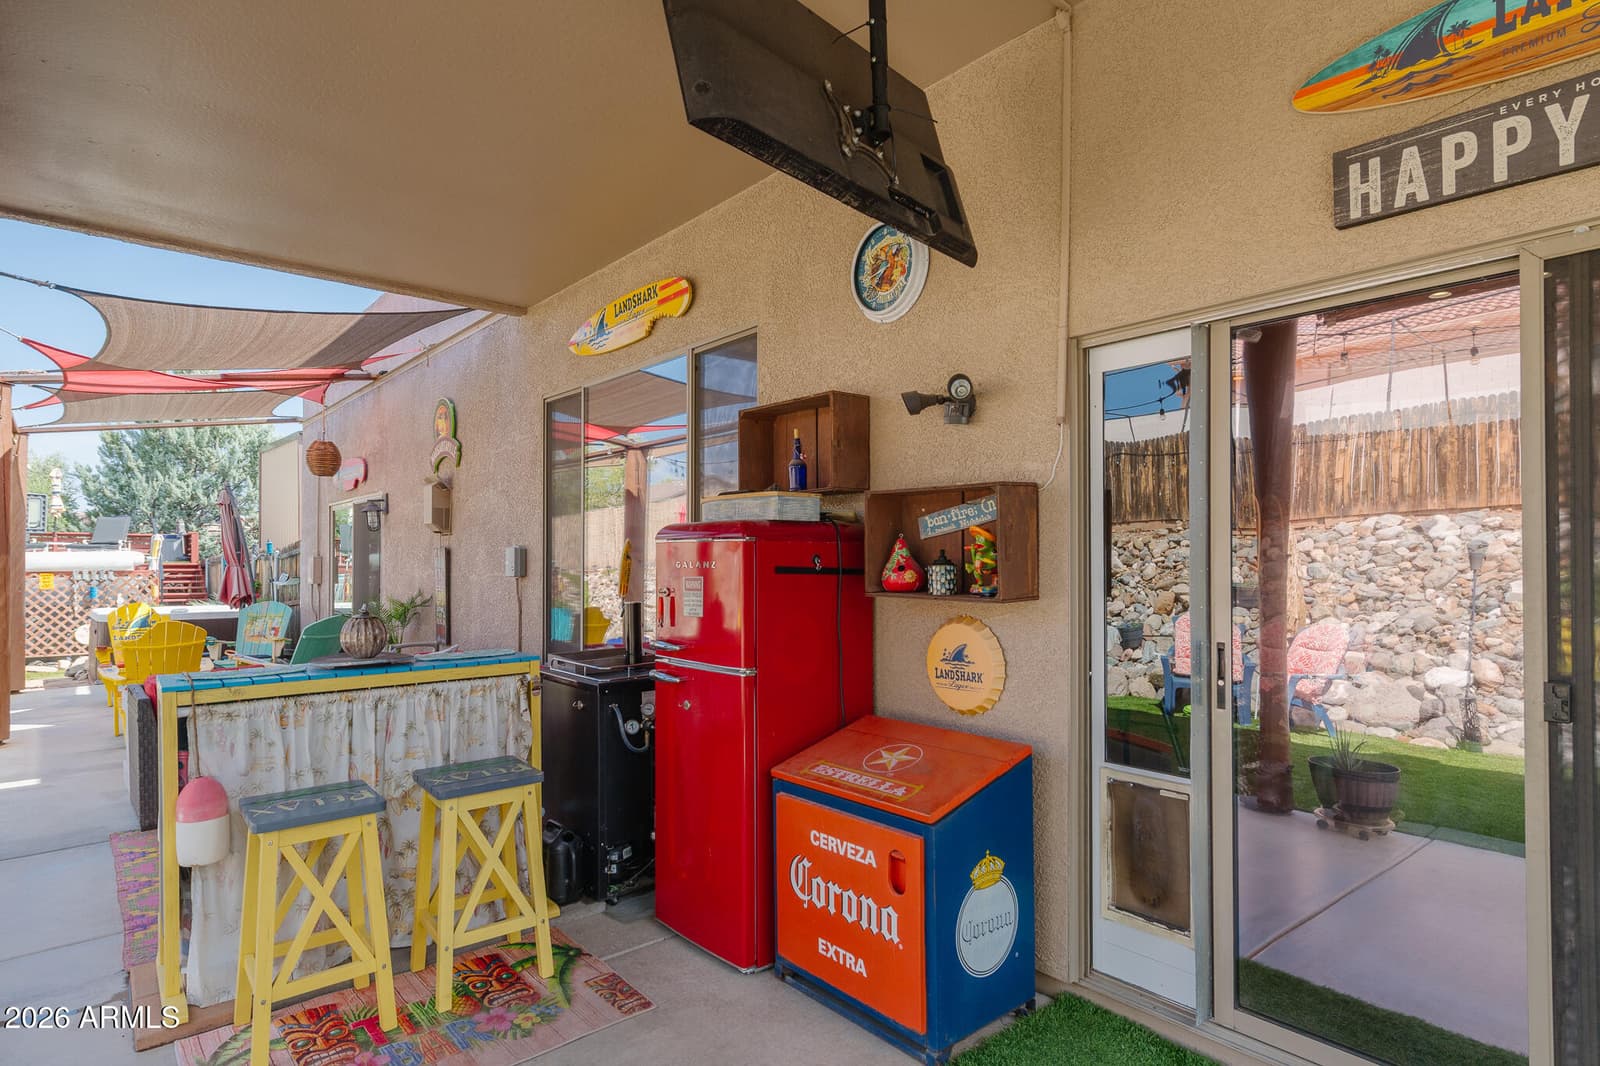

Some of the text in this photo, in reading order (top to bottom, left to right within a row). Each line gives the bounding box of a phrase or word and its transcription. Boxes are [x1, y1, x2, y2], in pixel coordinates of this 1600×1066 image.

[1502, 26, 1567, 57] PREMIUM
[1499, 88, 1562, 116] EVERY
[1348, 94, 1590, 220] HAPPY
[613, 284, 659, 318] LANDSHARK
[675, 560, 718, 569] GALANZ
[934, 666, 983, 684] LANDSHARK
[809, 829, 878, 869] CERVEZA
[789, 853, 901, 946] Corona
[961, 911, 1014, 946] Corona
[817, 936, 868, 978] EXTRA
[379, 1020, 496, 1066] BAR
